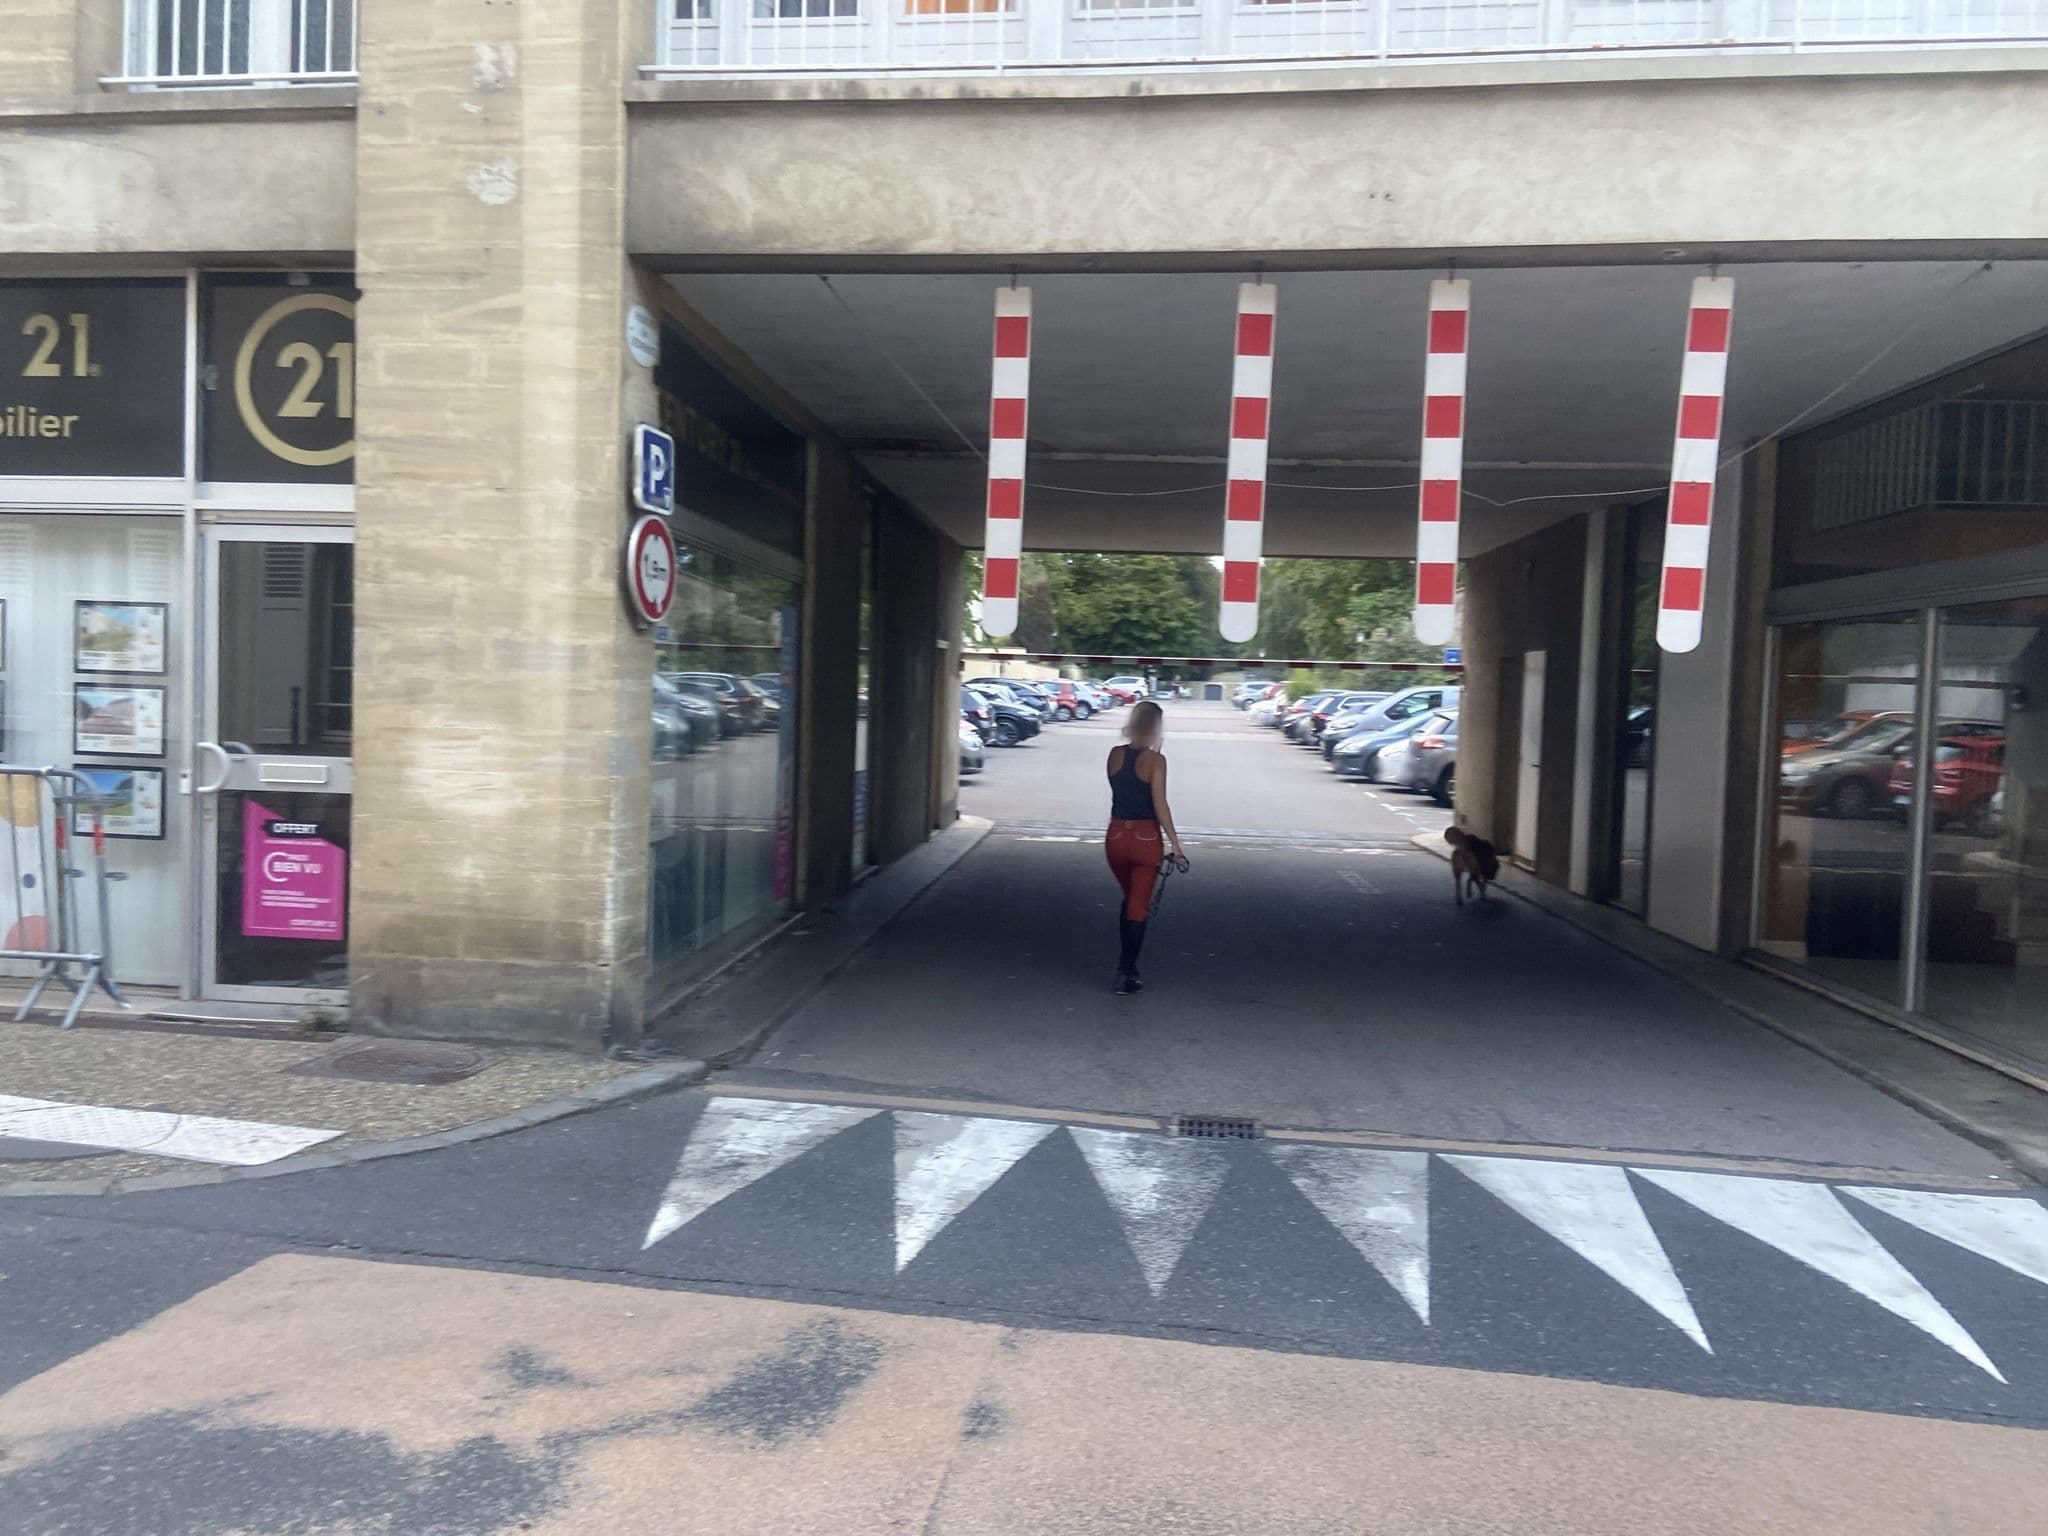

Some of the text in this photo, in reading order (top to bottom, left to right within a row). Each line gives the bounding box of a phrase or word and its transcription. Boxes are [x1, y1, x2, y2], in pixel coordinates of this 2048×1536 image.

[21, 313, 88, 377] 21
[276, 342, 354, 418] 21
[0, 405, 80, 438] ilier
[649, 443, 666, 494] P
[272, 822, 319, 835] OFFERT
